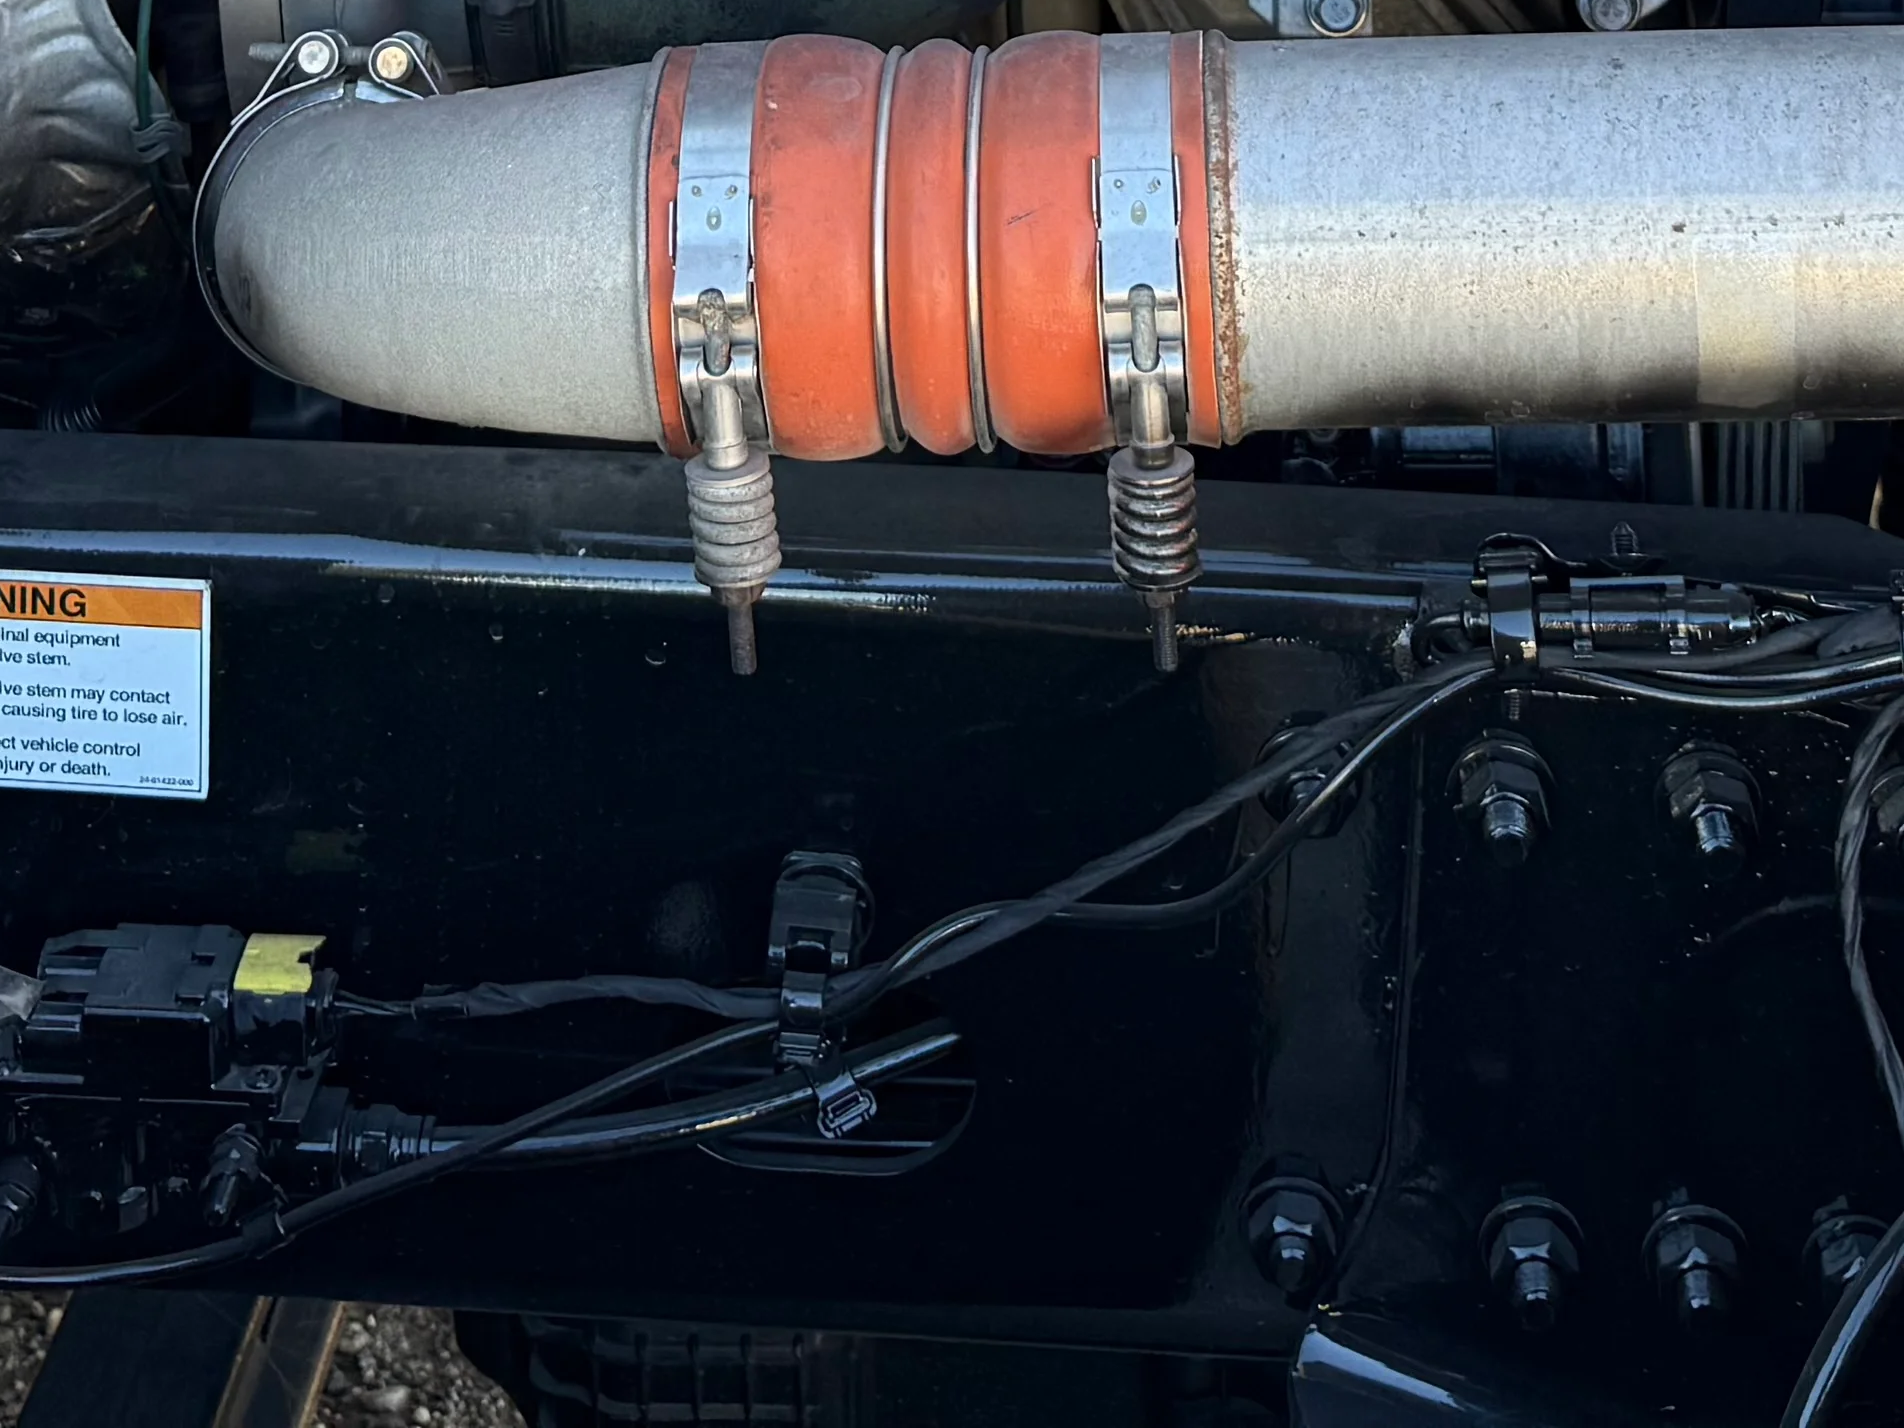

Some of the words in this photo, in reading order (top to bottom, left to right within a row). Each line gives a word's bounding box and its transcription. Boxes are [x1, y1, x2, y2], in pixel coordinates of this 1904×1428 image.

[34, 630, 120, 652] equipment
[26, 651, 71, 667] stem.
[26, 683, 68, 698] stem
[72, 685, 105, 704] may
[109, 688, 170, 705] contact
[1, 701, 66, 722] causing
[70, 704, 97, 720] tire
[102, 706, 119, 721] to
[123, 707, 157, 724] lose
[161, 710, 187, 726] air.
[21, 736, 79, 755] vehicle
[83, 740, 141, 757] control
[39, 759, 57, 773] or
[61, 759, 111, 777] death.
